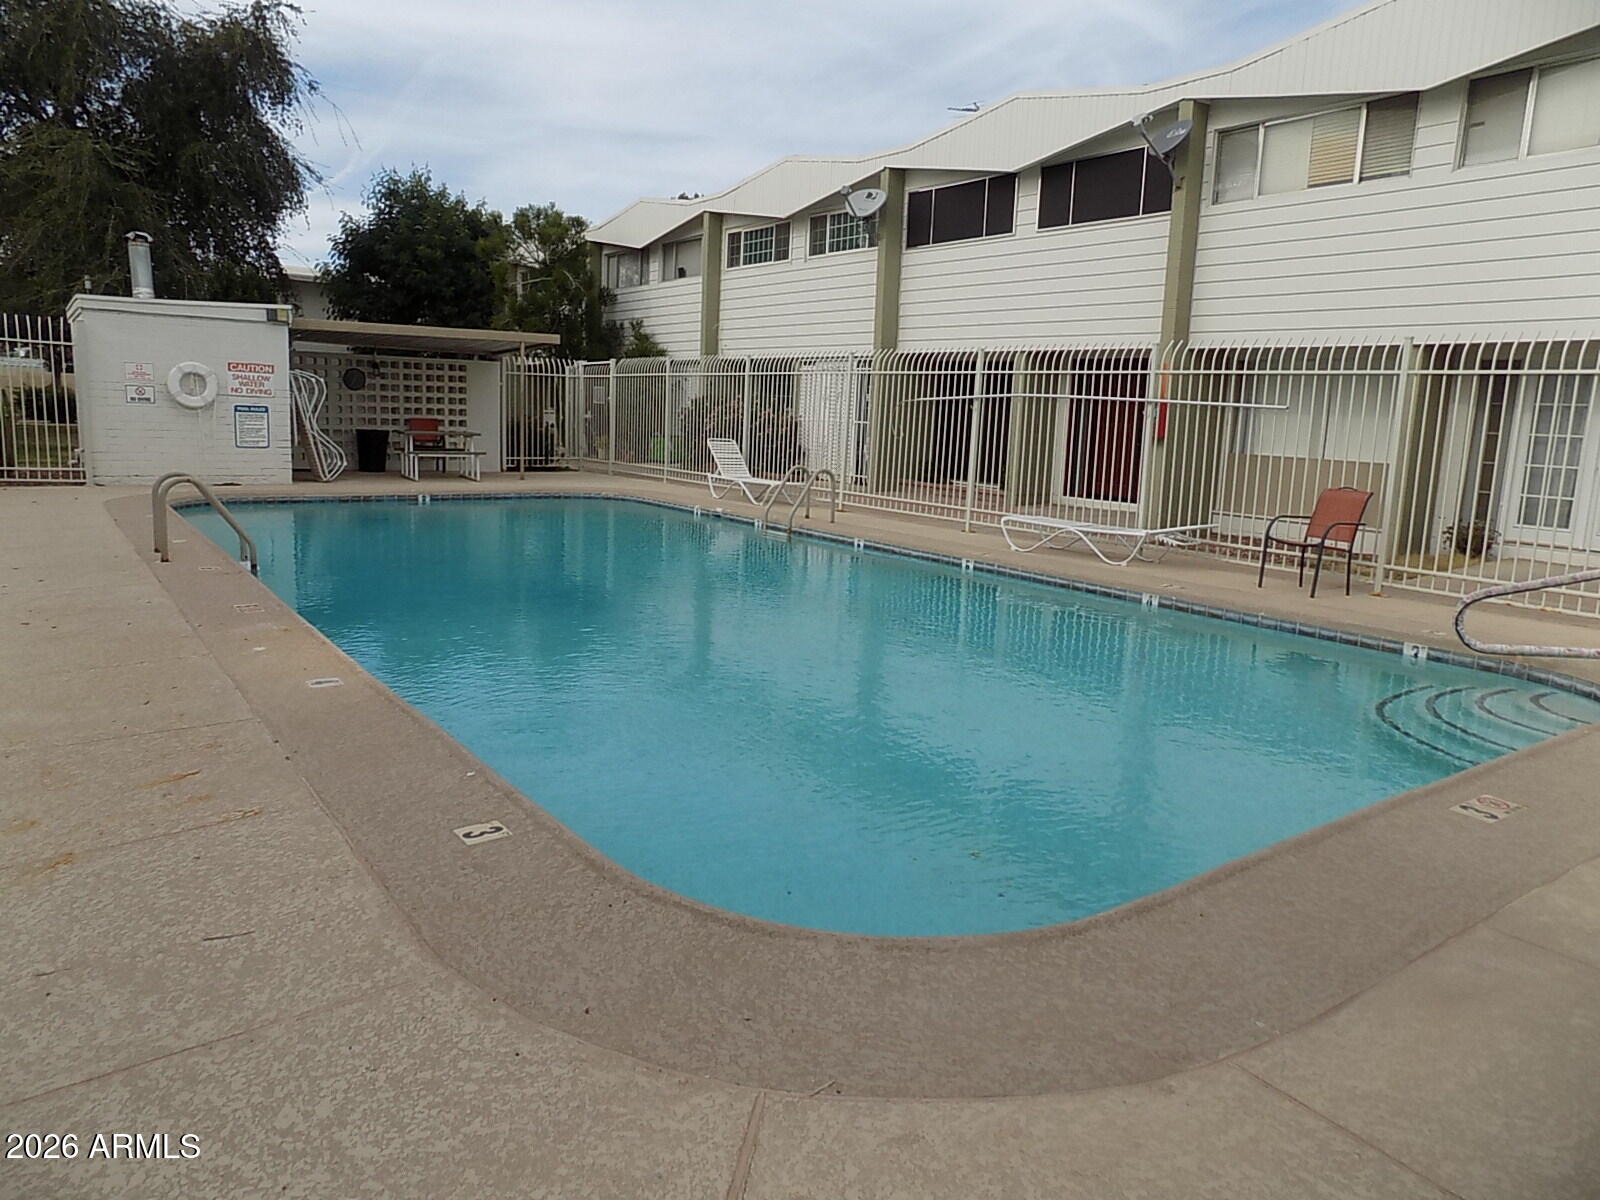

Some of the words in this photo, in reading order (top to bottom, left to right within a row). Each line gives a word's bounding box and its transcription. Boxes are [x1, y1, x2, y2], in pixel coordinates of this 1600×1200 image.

[230, 363, 273, 373] CAUTION
[231, 373, 271, 382] SHALLOW
[238, 380, 266, 388] WATER
[246, 388, 273, 396] DIVING
[462, 826, 504, 839] 3
